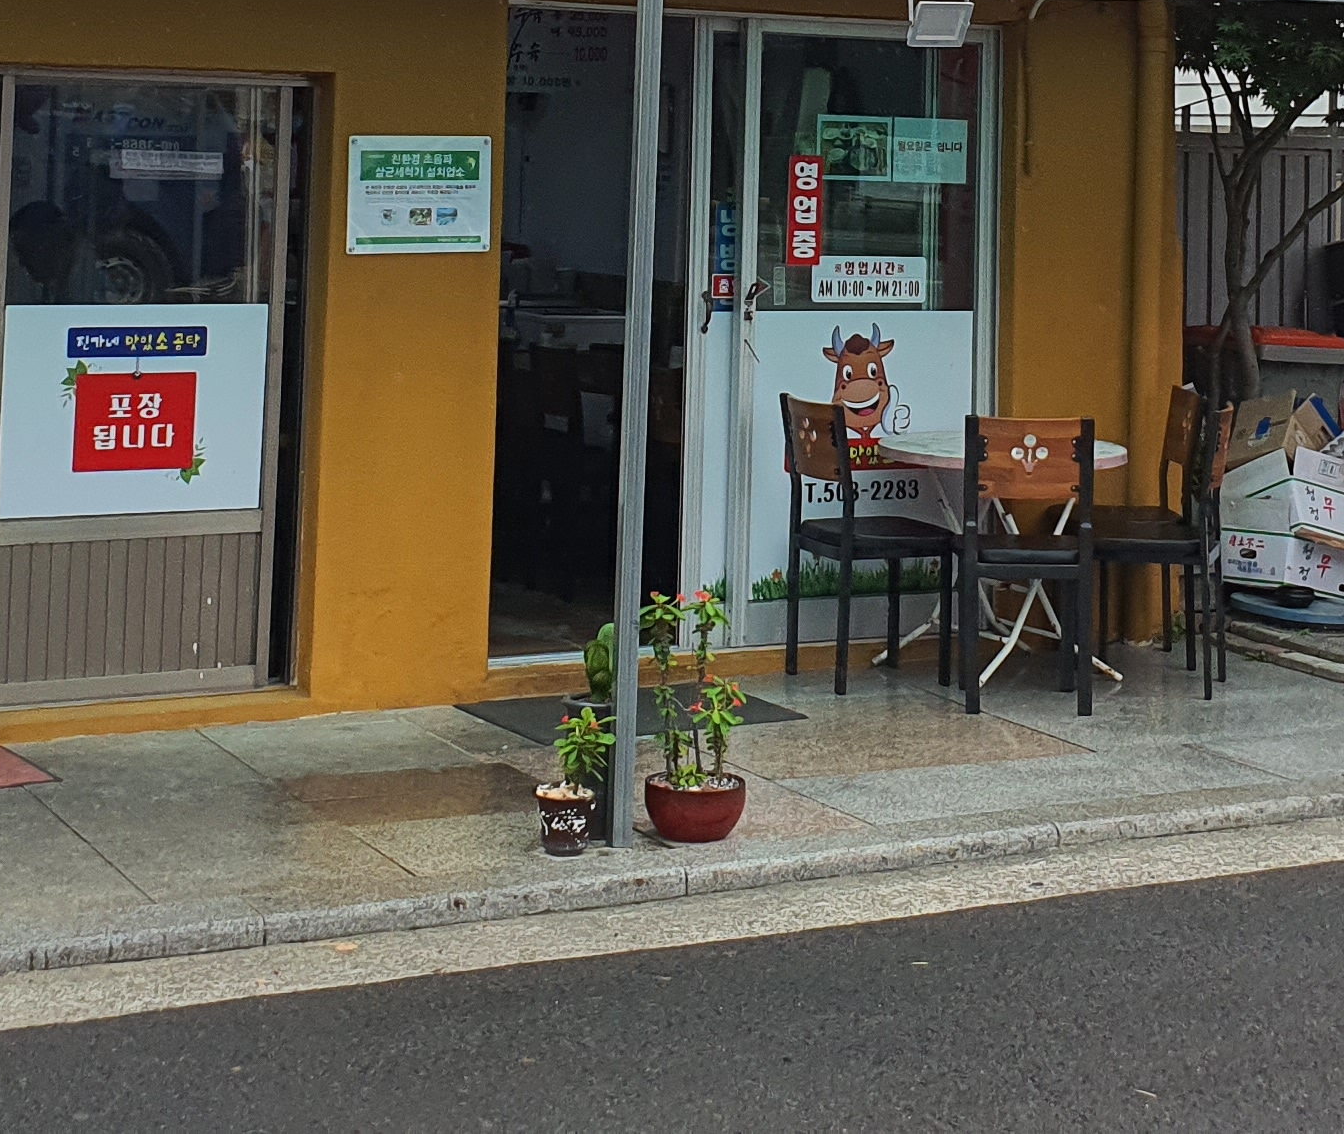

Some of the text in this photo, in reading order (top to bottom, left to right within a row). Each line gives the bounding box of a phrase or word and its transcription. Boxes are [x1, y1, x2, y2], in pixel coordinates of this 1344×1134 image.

[792, 161, 819, 259] 영업중
[844, 261, 896, 276] 영업시간
[818, 279, 833, 297] AM
[837, 280, 864, 297] 10:00
[875, 280, 889, 297] PM
[892, 280, 920, 297] 21:00
[76, 334, 120, 351] 진가네
[108, 393, 163, 418] 포장
[93, 423, 175, 451] 됩니다
[1323, 497, 1336, 520] 무
